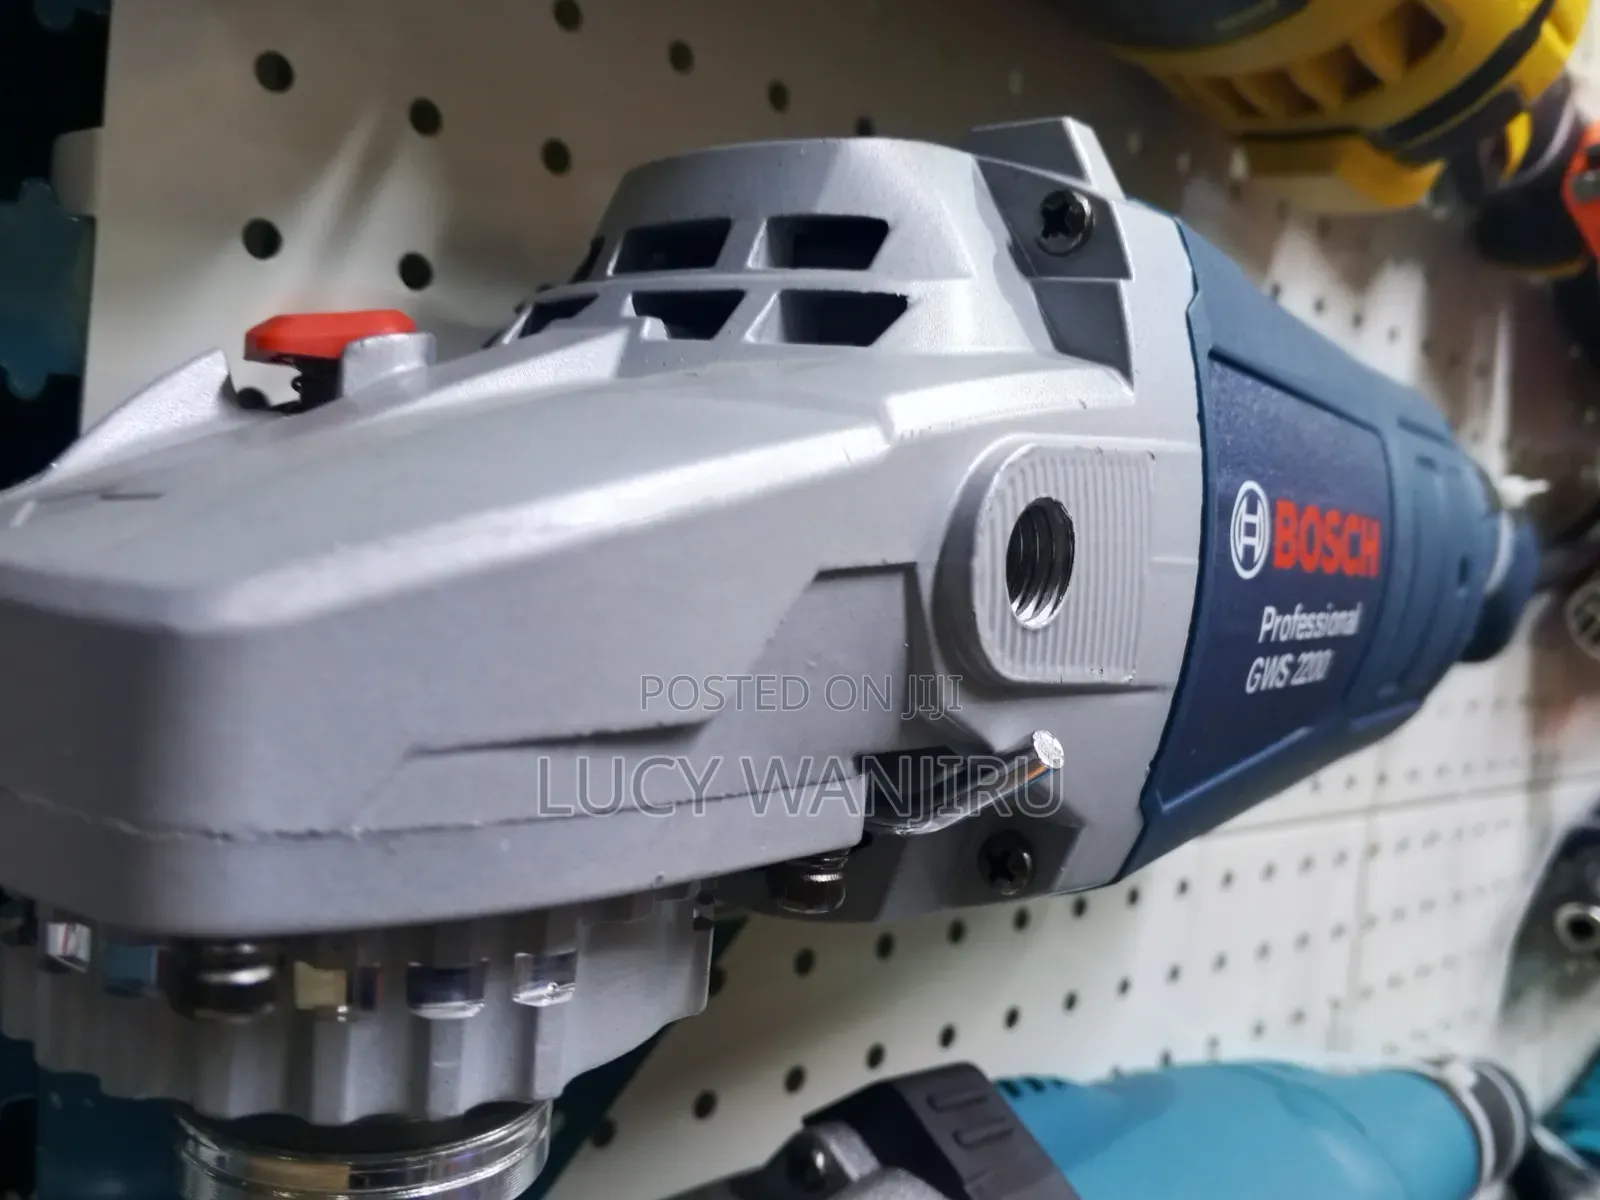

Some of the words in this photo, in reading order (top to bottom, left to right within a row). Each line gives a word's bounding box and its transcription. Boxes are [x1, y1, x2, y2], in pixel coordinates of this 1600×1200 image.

[1274, 498, 1380, 577] BOSCH
[1258, 602, 1362, 643] Professional
[1245, 653, 1294, 694] GWS
